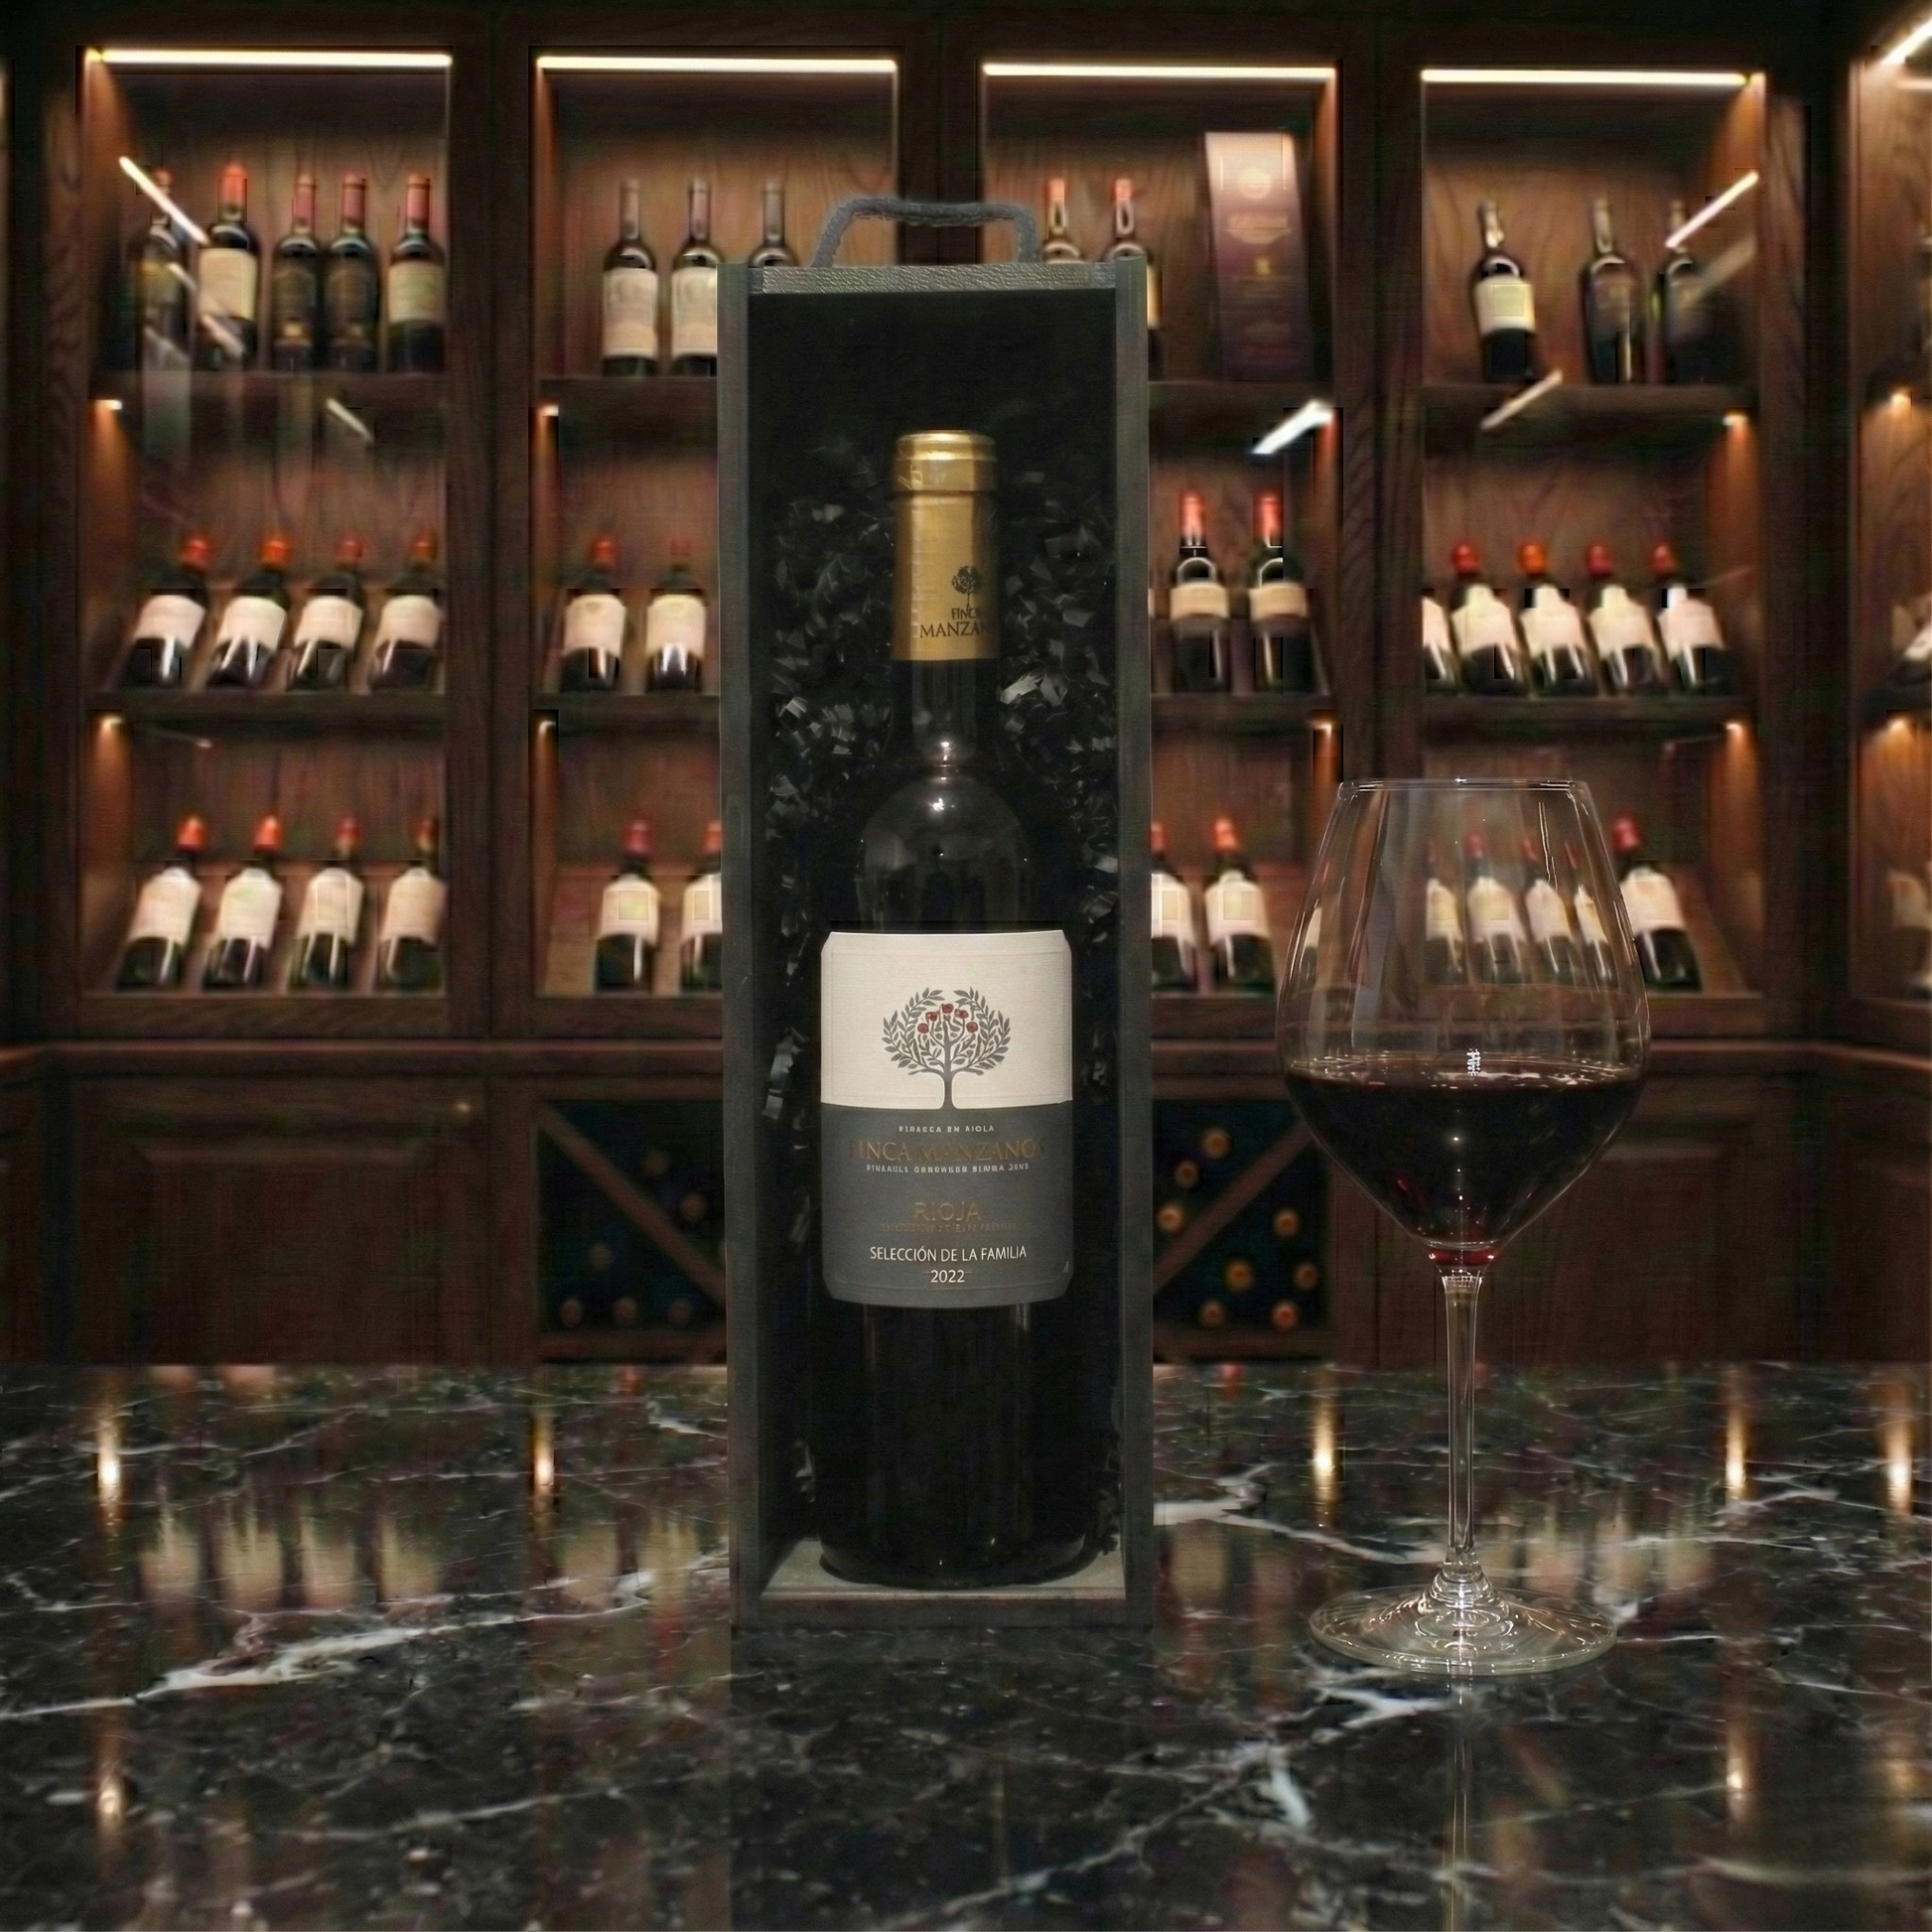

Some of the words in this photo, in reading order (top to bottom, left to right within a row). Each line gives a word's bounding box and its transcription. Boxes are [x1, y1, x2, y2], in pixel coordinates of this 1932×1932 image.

[913, 1201, 982, 1222] RIOJA
[870, 1245, 937, 1263] SELECCIÓN
[940, 1248, 958, 1262] DE
[961, 1248, 978, 1262] LA
[981, 1245, 1028, 1261] FAMILIA
[930, 1269, 966, 1284] 2022
